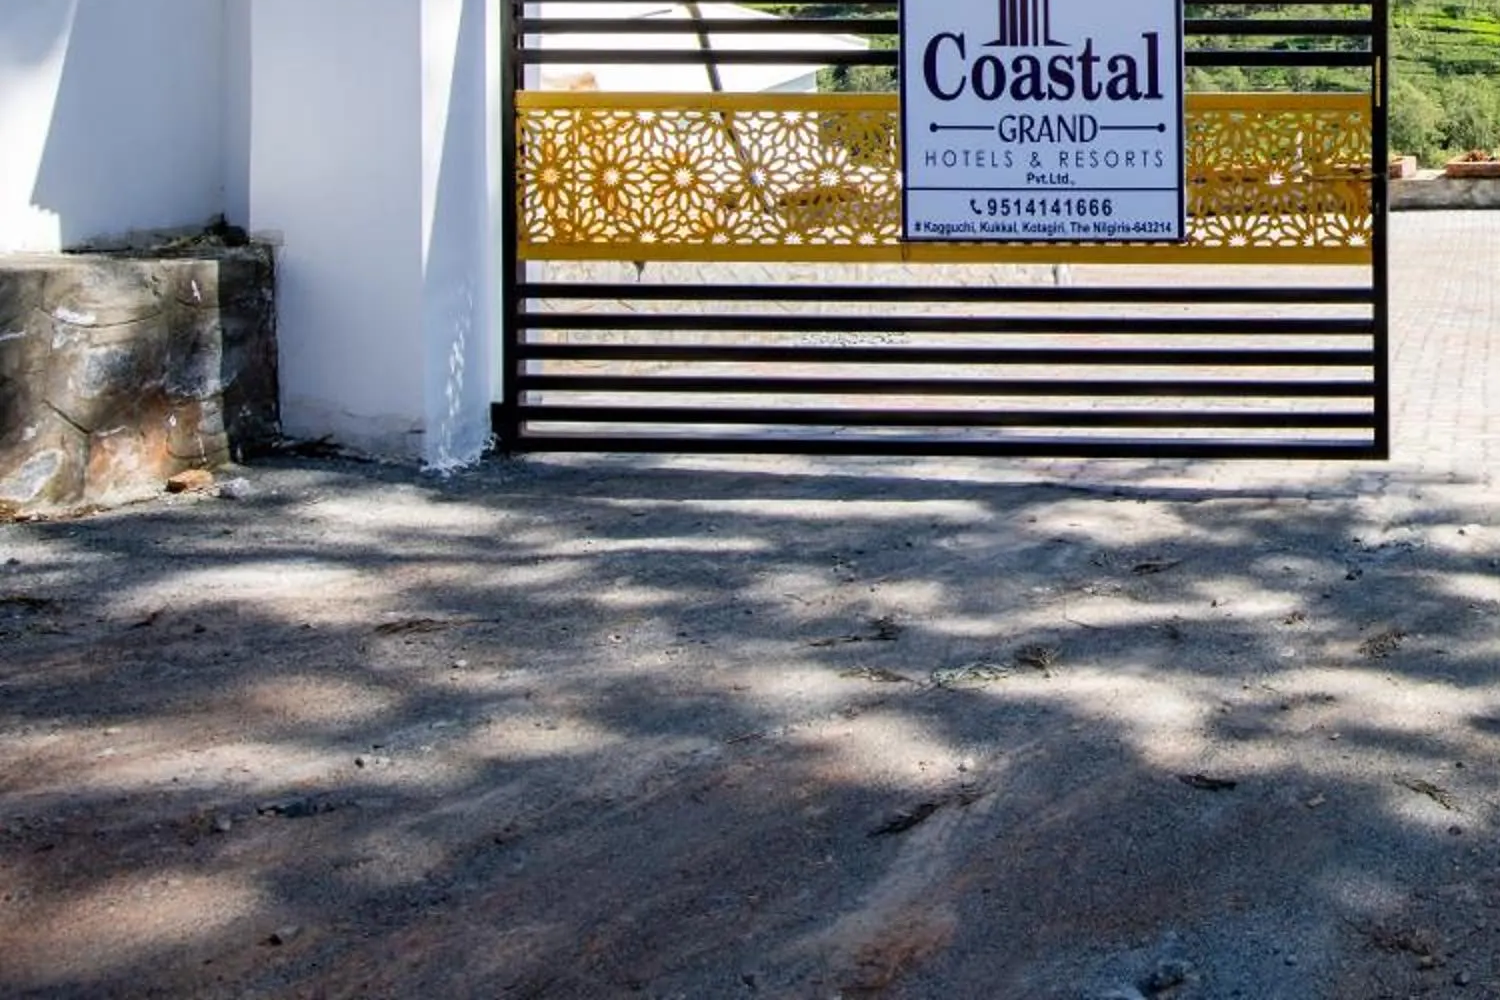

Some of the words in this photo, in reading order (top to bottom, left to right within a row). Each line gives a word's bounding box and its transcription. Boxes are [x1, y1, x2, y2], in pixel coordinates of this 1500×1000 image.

[923, 32, 1164, 101] Coastal
[998, 114, 1098, 144] GRAND
[924, 150, 1013, 168] HOTELS
[1029, 151, 1041, 169] &
[1059, 150, 1164, 168] RESORTS
[987, 198, 1113, 217] 9514141666
[1069, 221, 1090, 233] The
